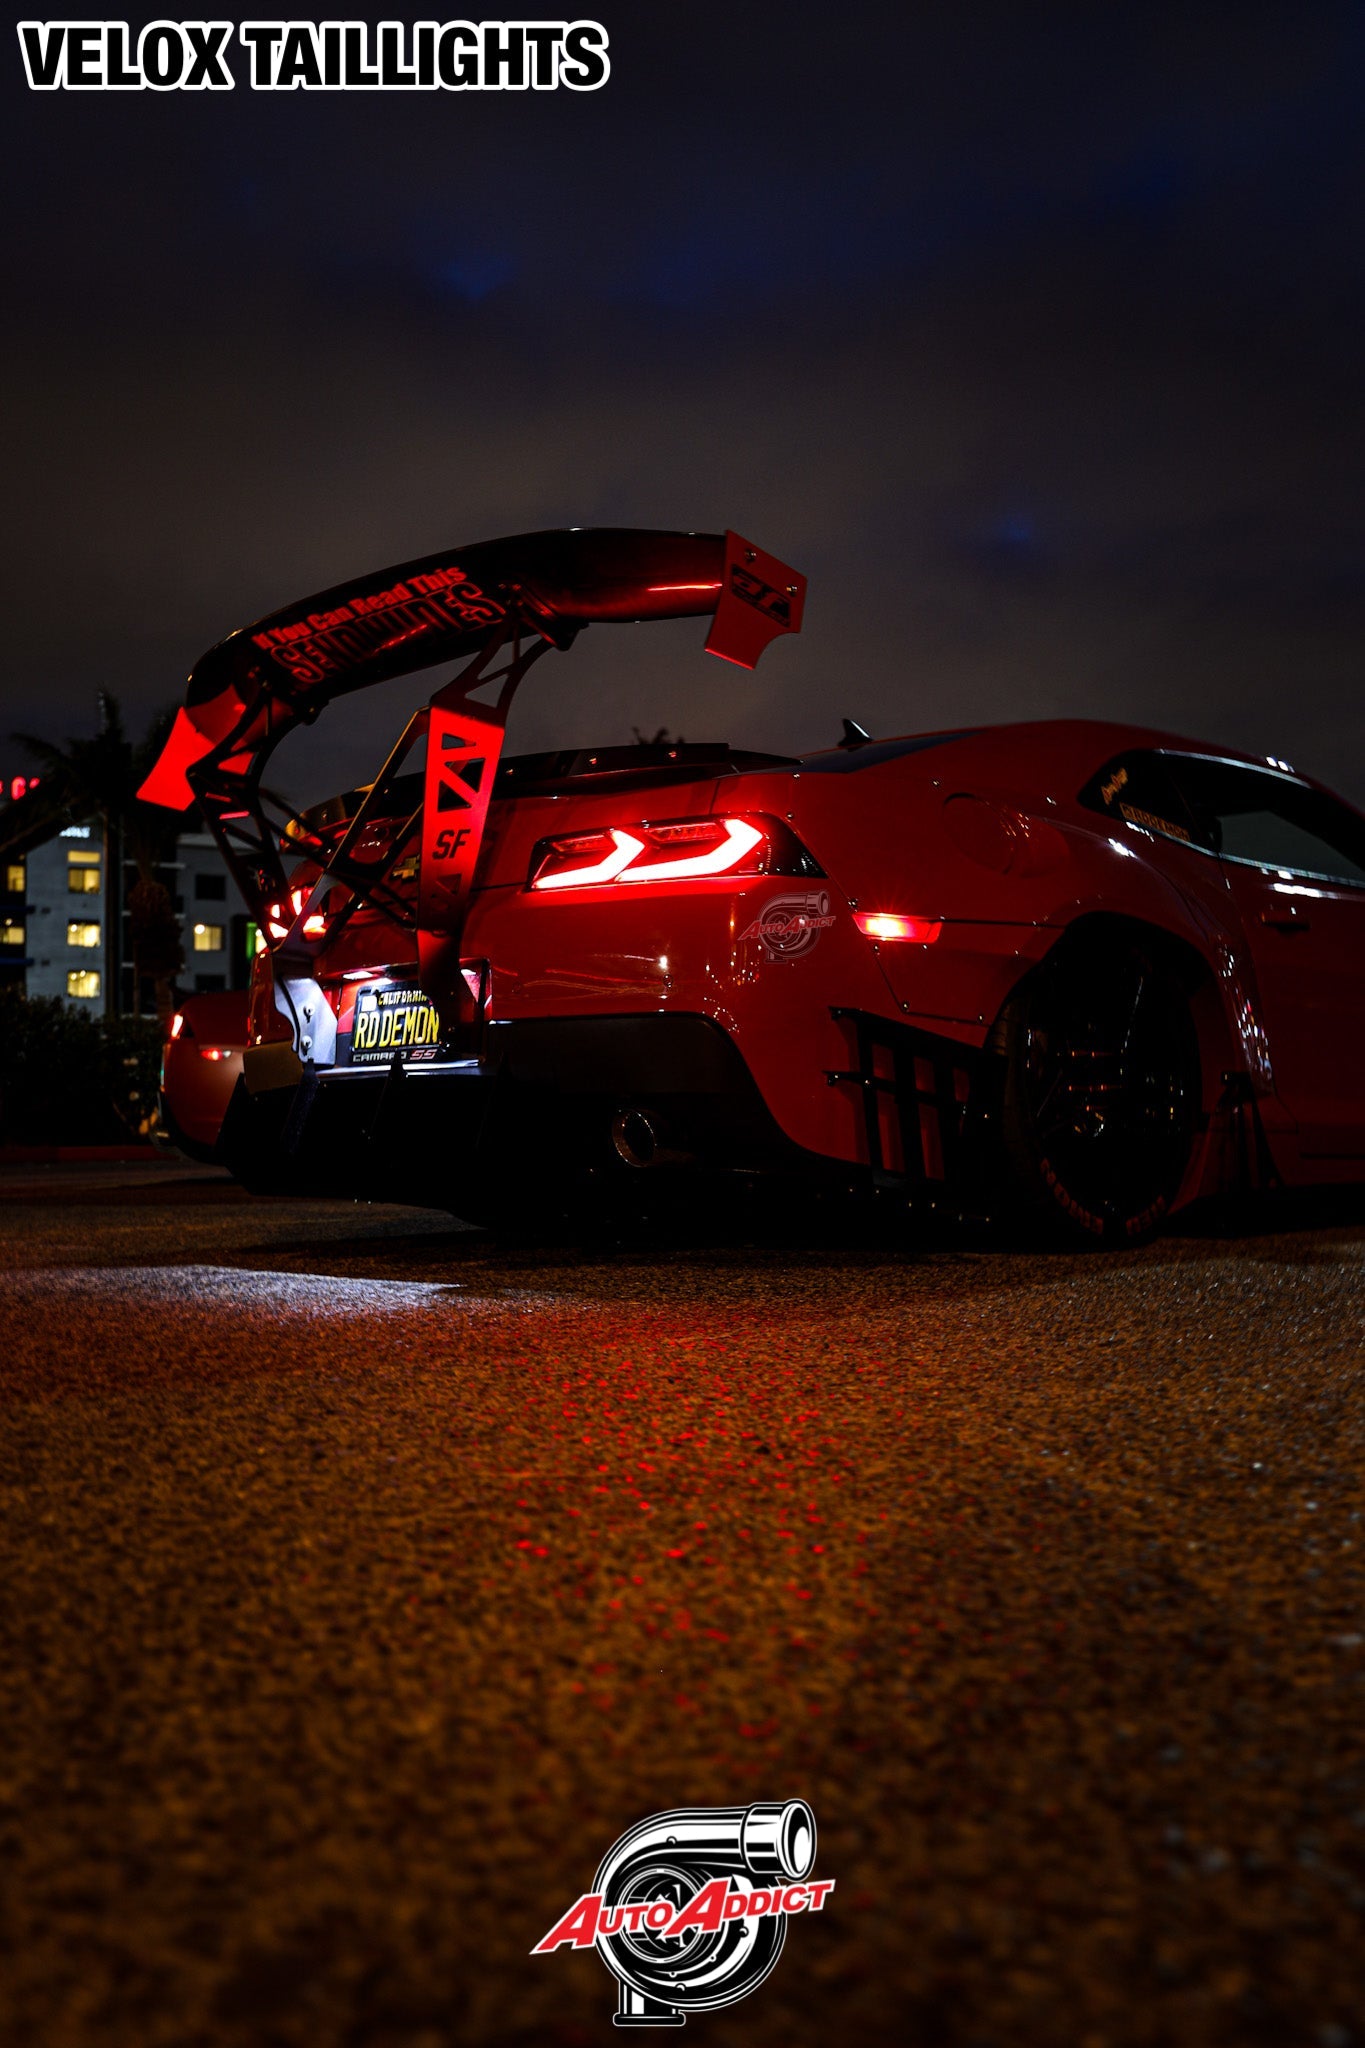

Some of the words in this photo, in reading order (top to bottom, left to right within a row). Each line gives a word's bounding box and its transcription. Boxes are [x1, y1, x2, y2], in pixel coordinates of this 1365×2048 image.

[267, 621, 313, 645] You
[306, 605, 356, 631] Can
[348, 581, 414, 617] Read
[406, 565, 468, 595] This
[432, 828, 472, 860] SF
[409, 1048, 438, 1061] SS
